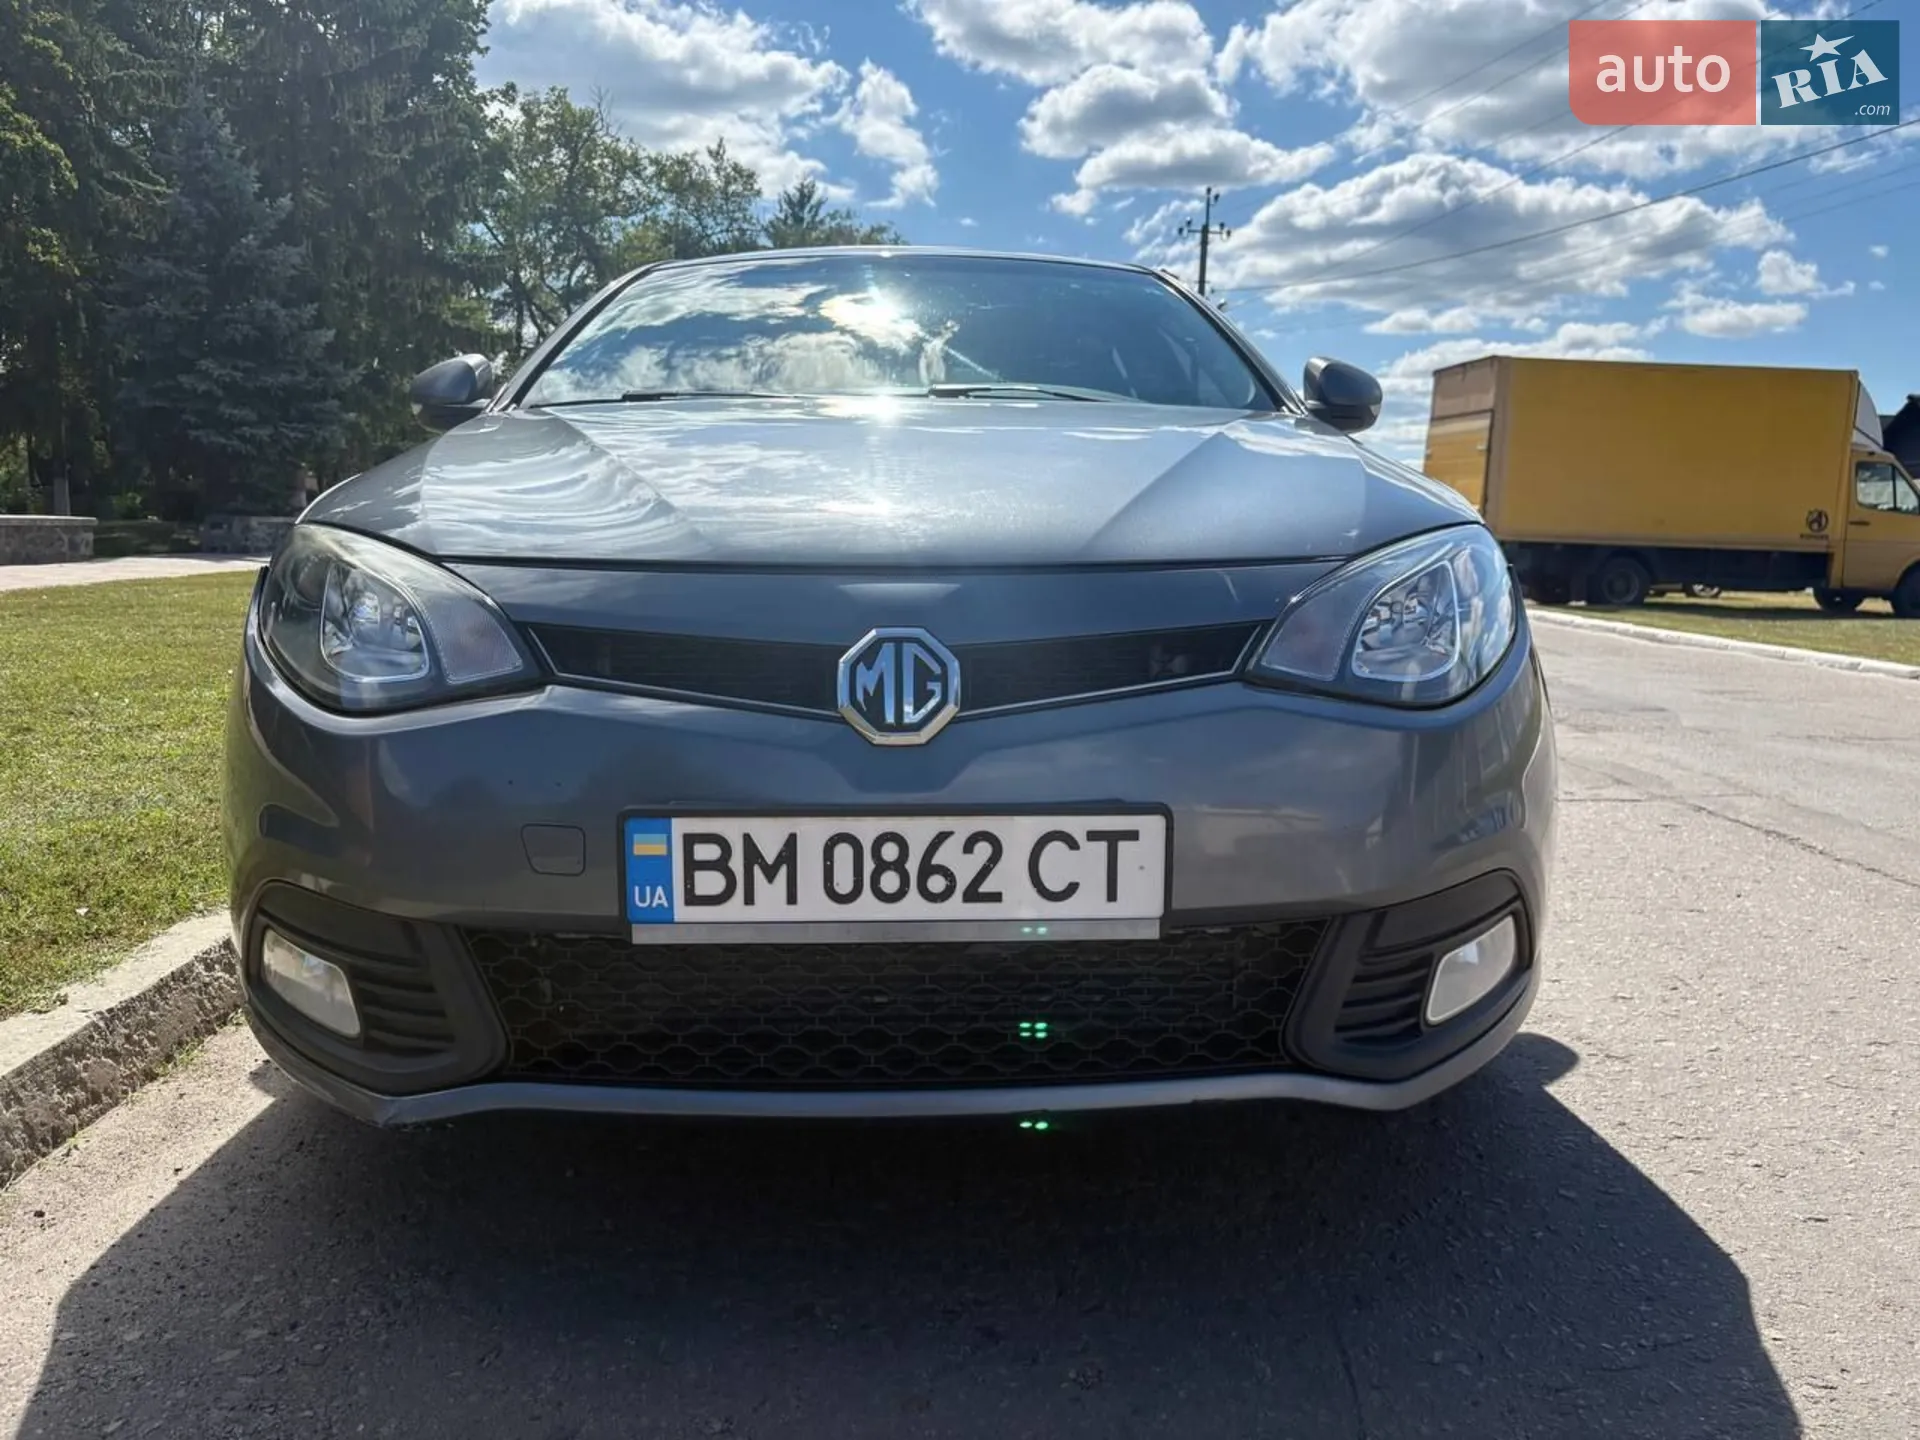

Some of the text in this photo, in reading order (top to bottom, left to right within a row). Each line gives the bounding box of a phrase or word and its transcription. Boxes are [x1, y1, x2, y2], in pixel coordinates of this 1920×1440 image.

[856, 642, 942, 724] MG
[634, 886, 669, 908] UA
[683, 829, 1140, 906] BM 0862 CT
